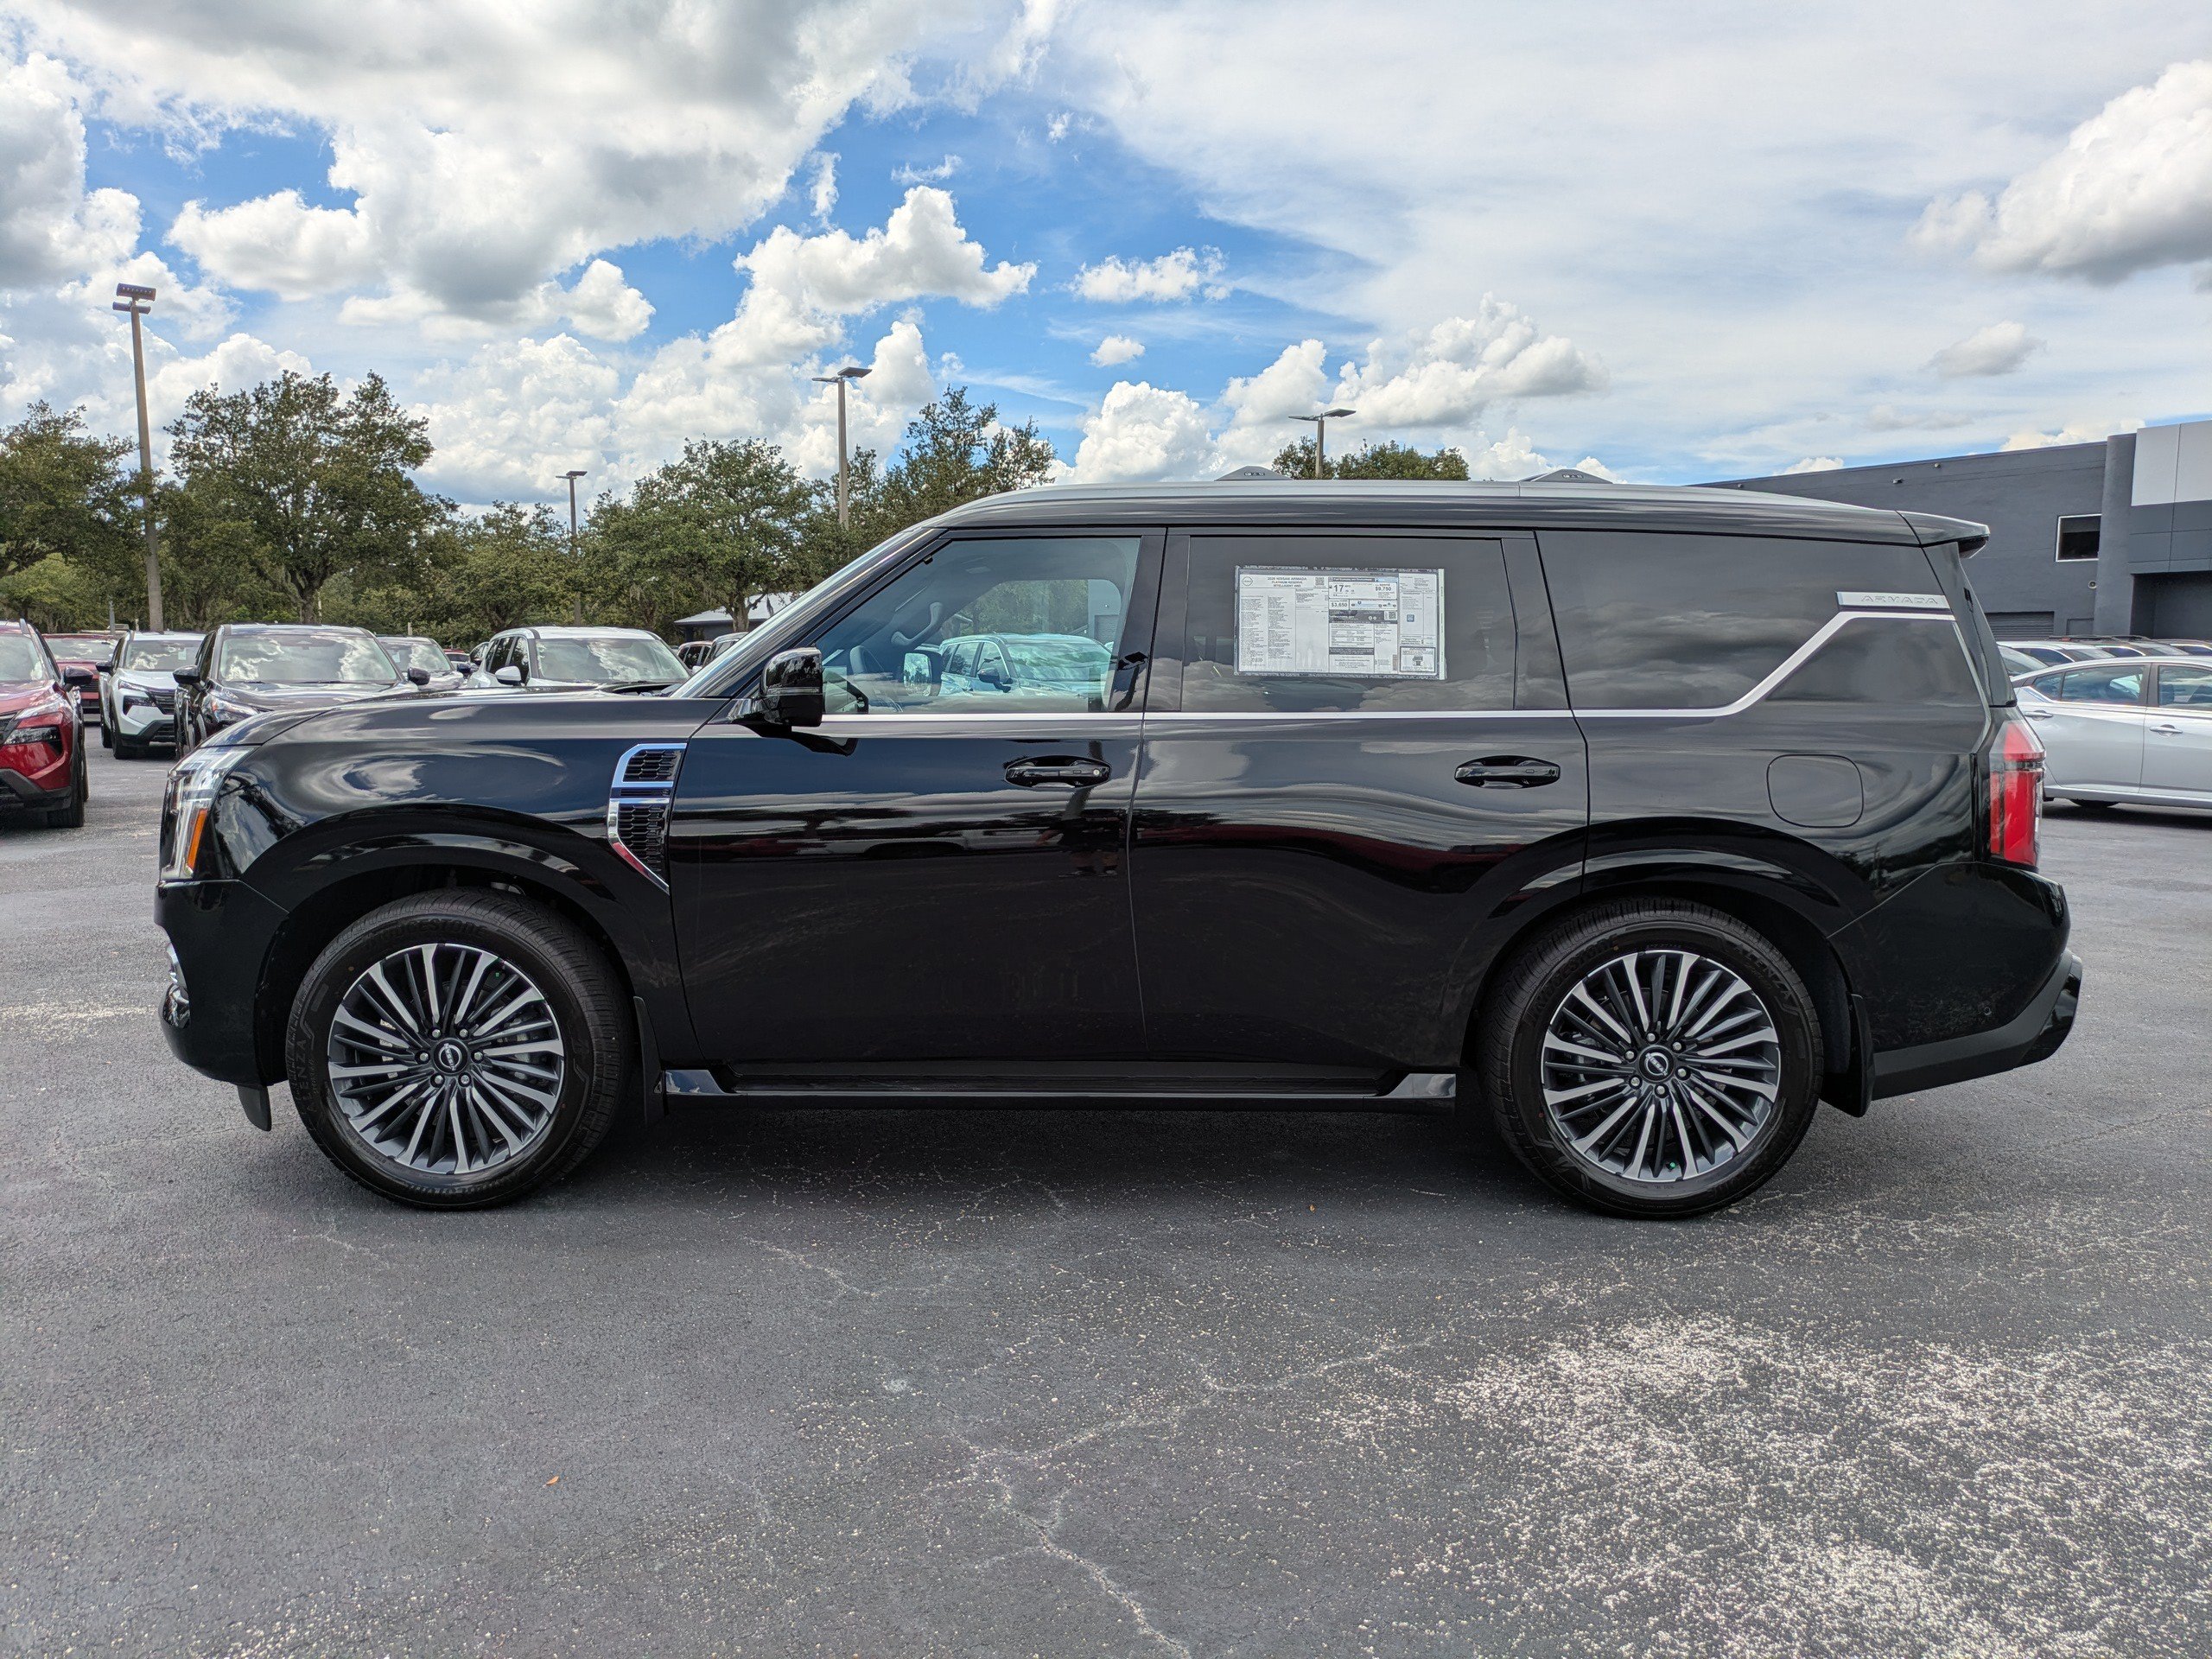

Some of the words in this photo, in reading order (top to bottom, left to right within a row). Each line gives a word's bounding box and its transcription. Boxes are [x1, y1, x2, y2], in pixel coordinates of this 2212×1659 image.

[1334, 584, 1344, 593] 17
[1861, 595, 1938, 605] ARMADA
[443, 1042, 456, 1071] NISSAN
